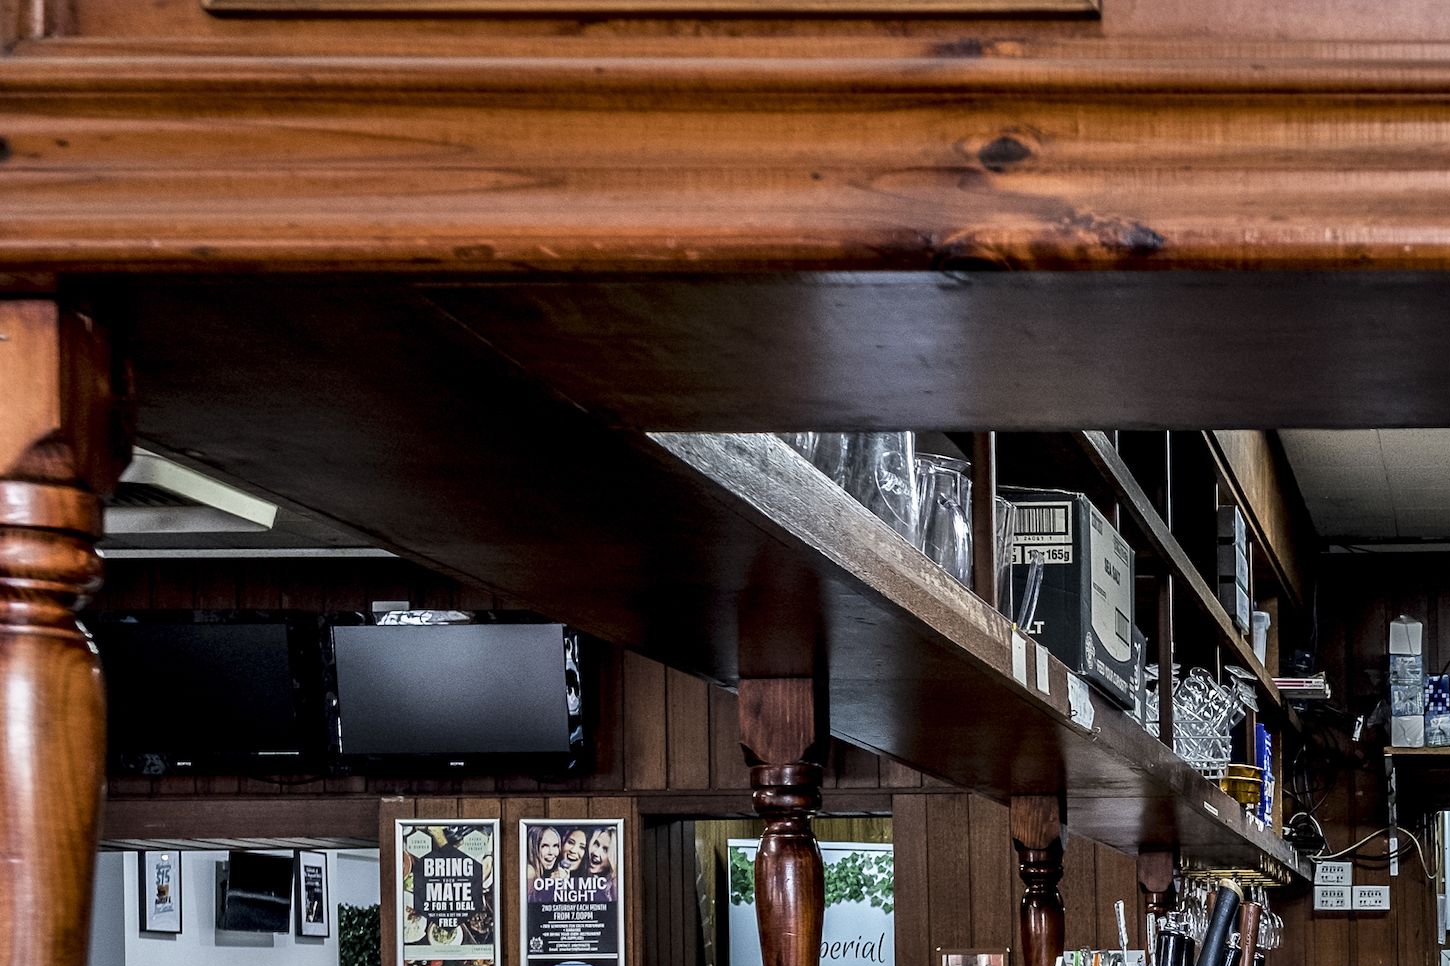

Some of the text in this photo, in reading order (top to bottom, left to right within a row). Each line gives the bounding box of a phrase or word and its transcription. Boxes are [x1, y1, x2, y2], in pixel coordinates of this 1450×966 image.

[423, 858, 474, 877] BRING
[534, 876, 607, 891] OPEN MIC
[426, 882, 472, 901] MATE
[553, 890, 597, 902] NIGHT
[423, 902, 475, 911] 2 FOR 1 DEAL
[439, 918, 458, 927] FREE
[553, 912, 570, 920] FROM
[819, 933, 886, 964] perial
